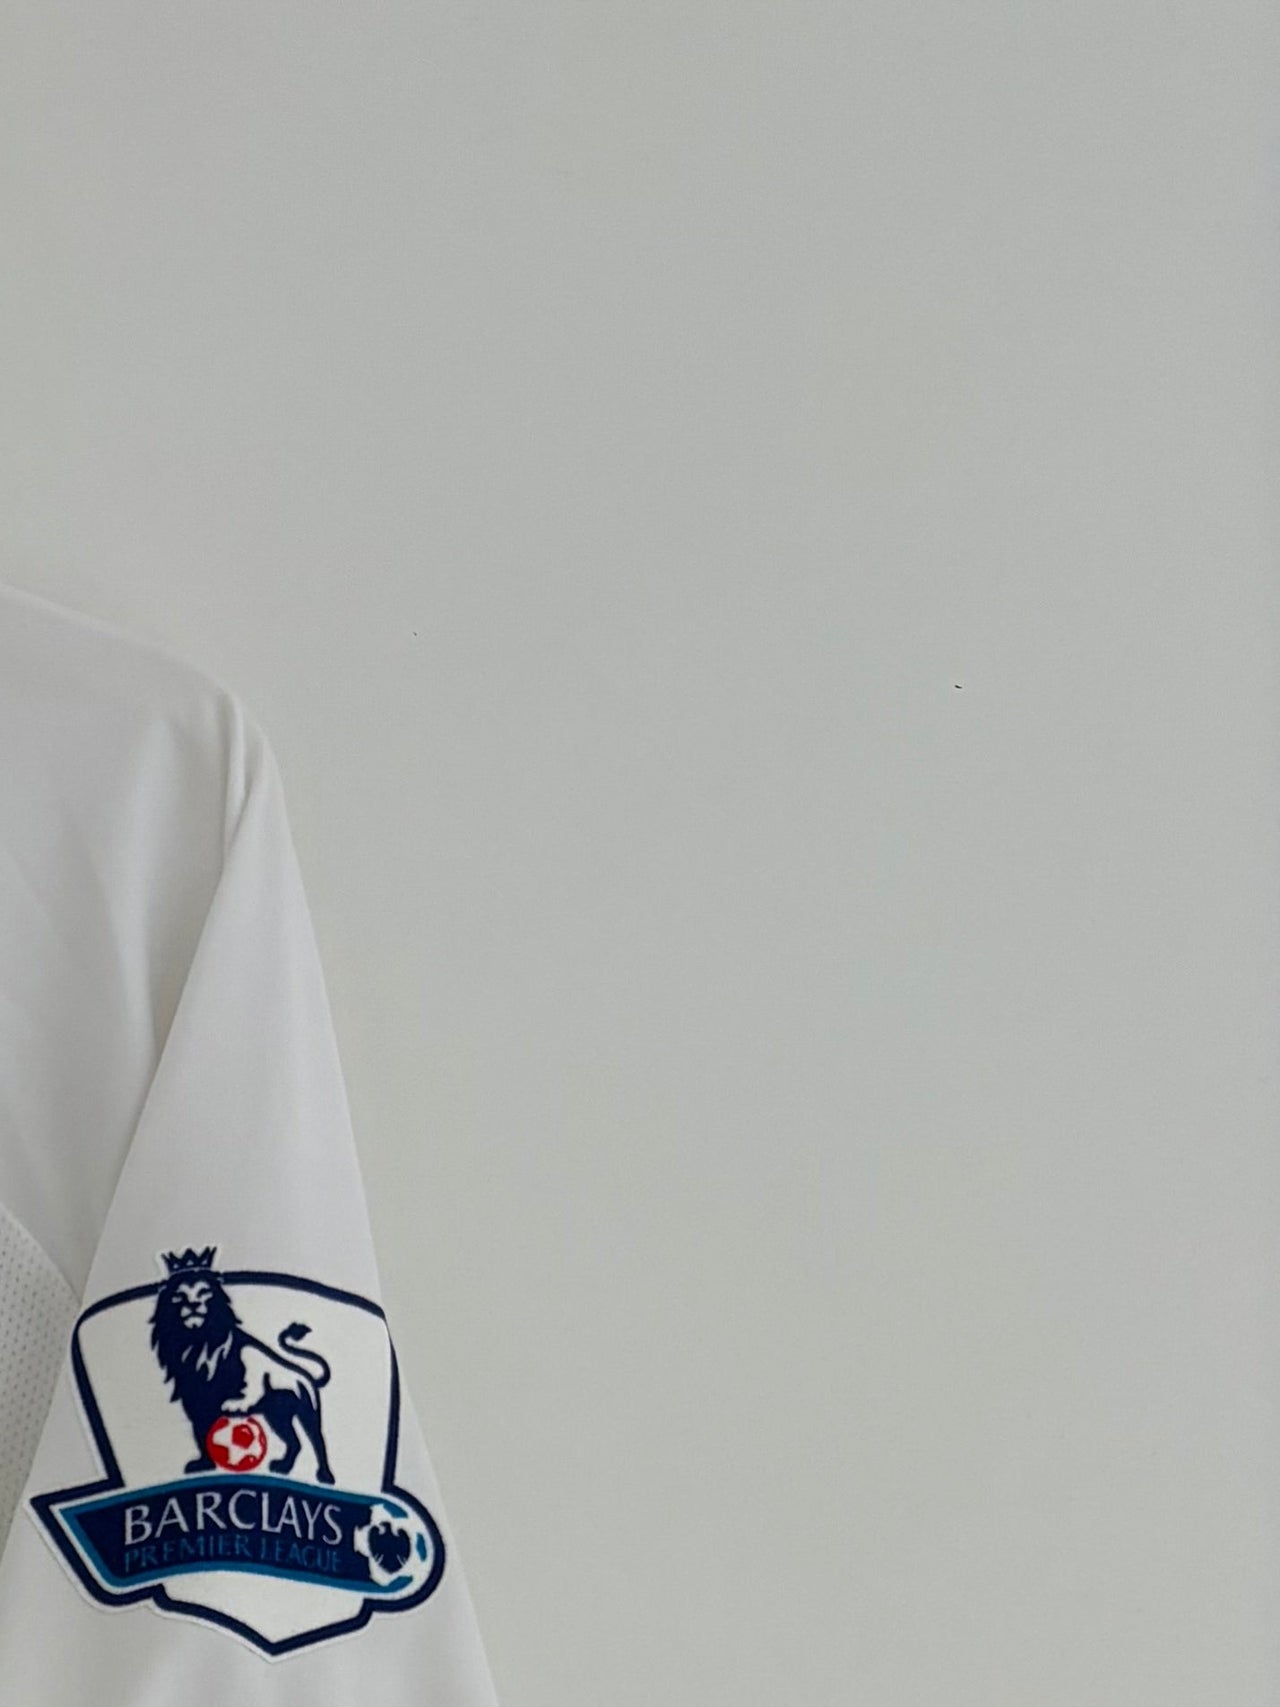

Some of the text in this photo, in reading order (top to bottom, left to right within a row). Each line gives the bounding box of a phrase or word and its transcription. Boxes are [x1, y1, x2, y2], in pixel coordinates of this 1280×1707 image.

[124, 1488, 343, 1546] BARCLAYS
[124, 1533, 342, 1573] PREMIER LEAGUE
